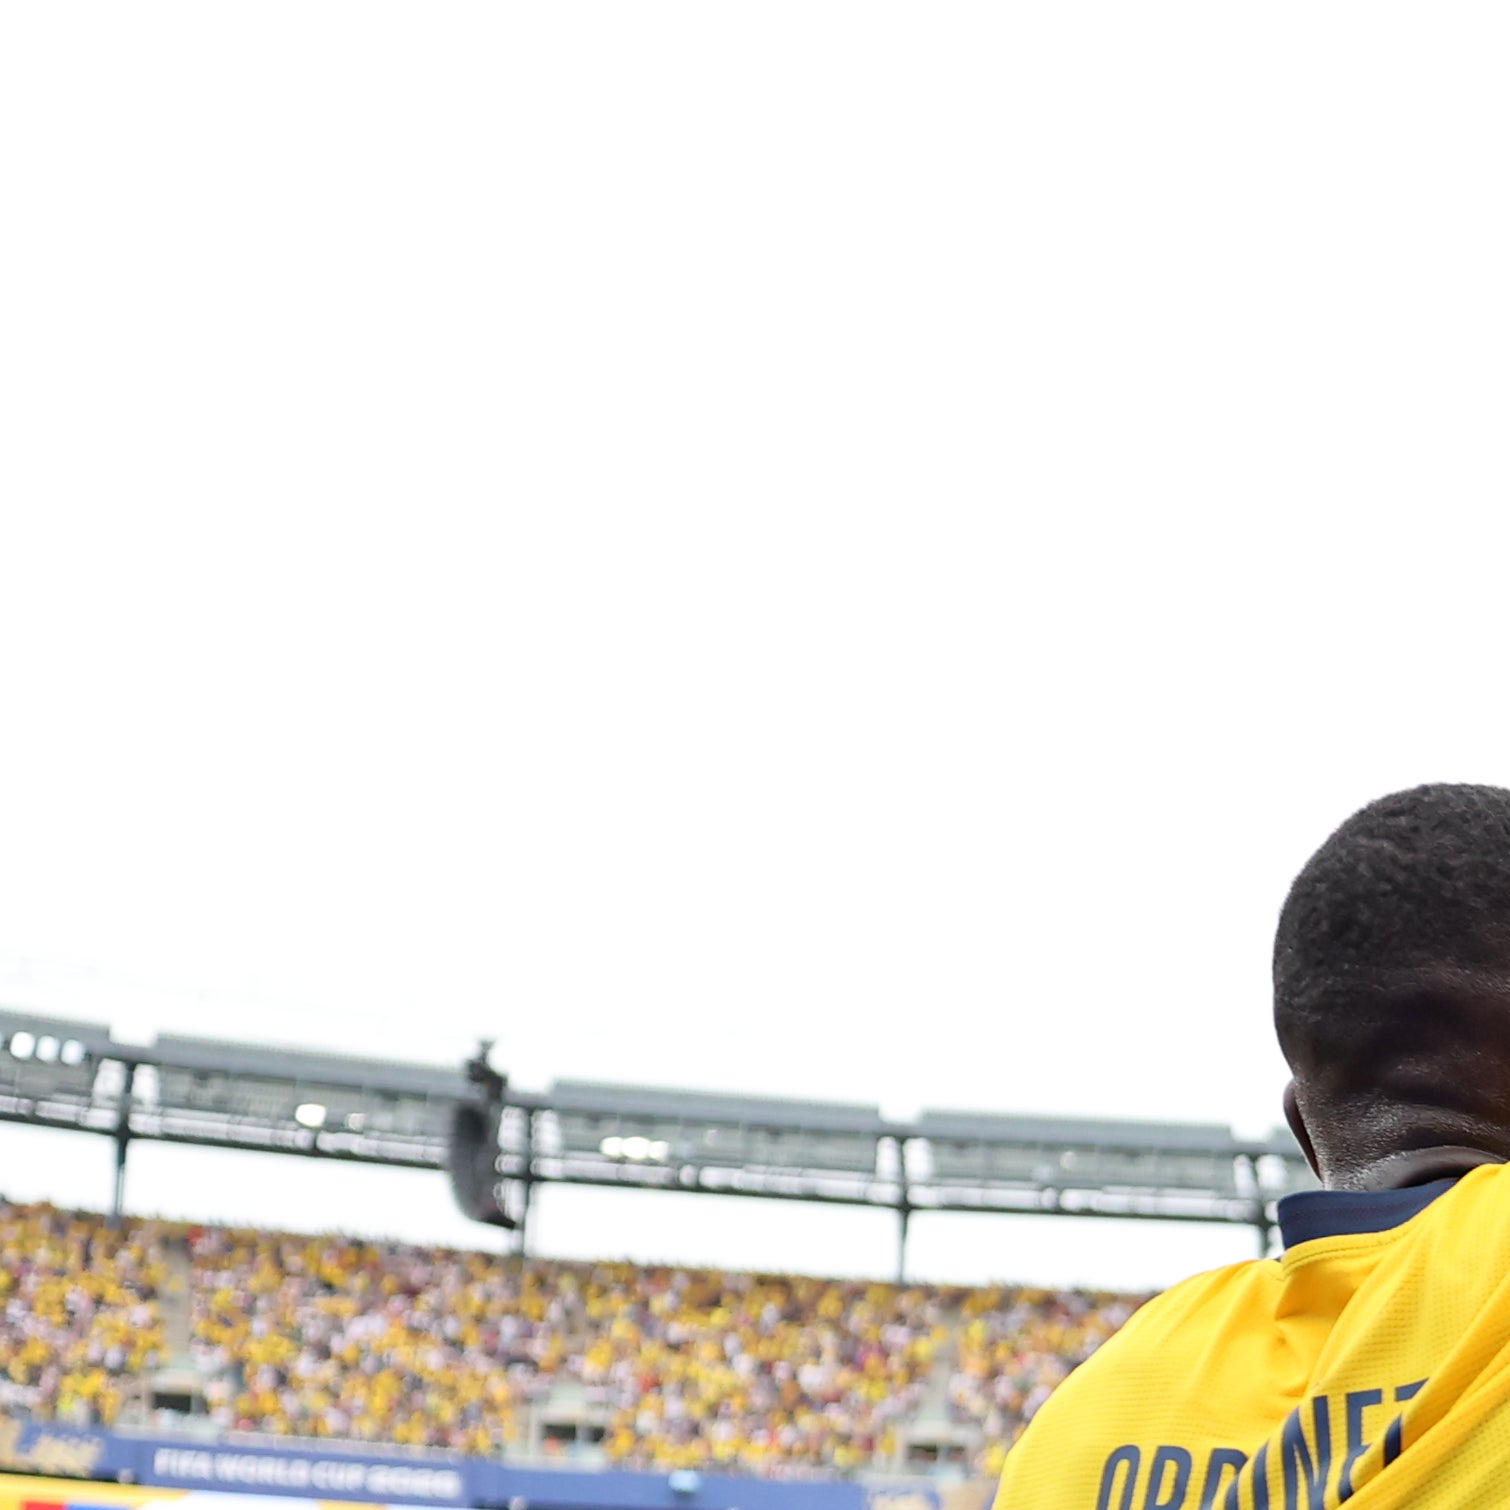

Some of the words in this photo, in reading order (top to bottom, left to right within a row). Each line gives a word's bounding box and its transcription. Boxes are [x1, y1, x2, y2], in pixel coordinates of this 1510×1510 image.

[154, 1447, 212, 1480] FIFA
[214, 1451, 310, 1487] WORLD
[311, 1460, 366, 1491] CUP
